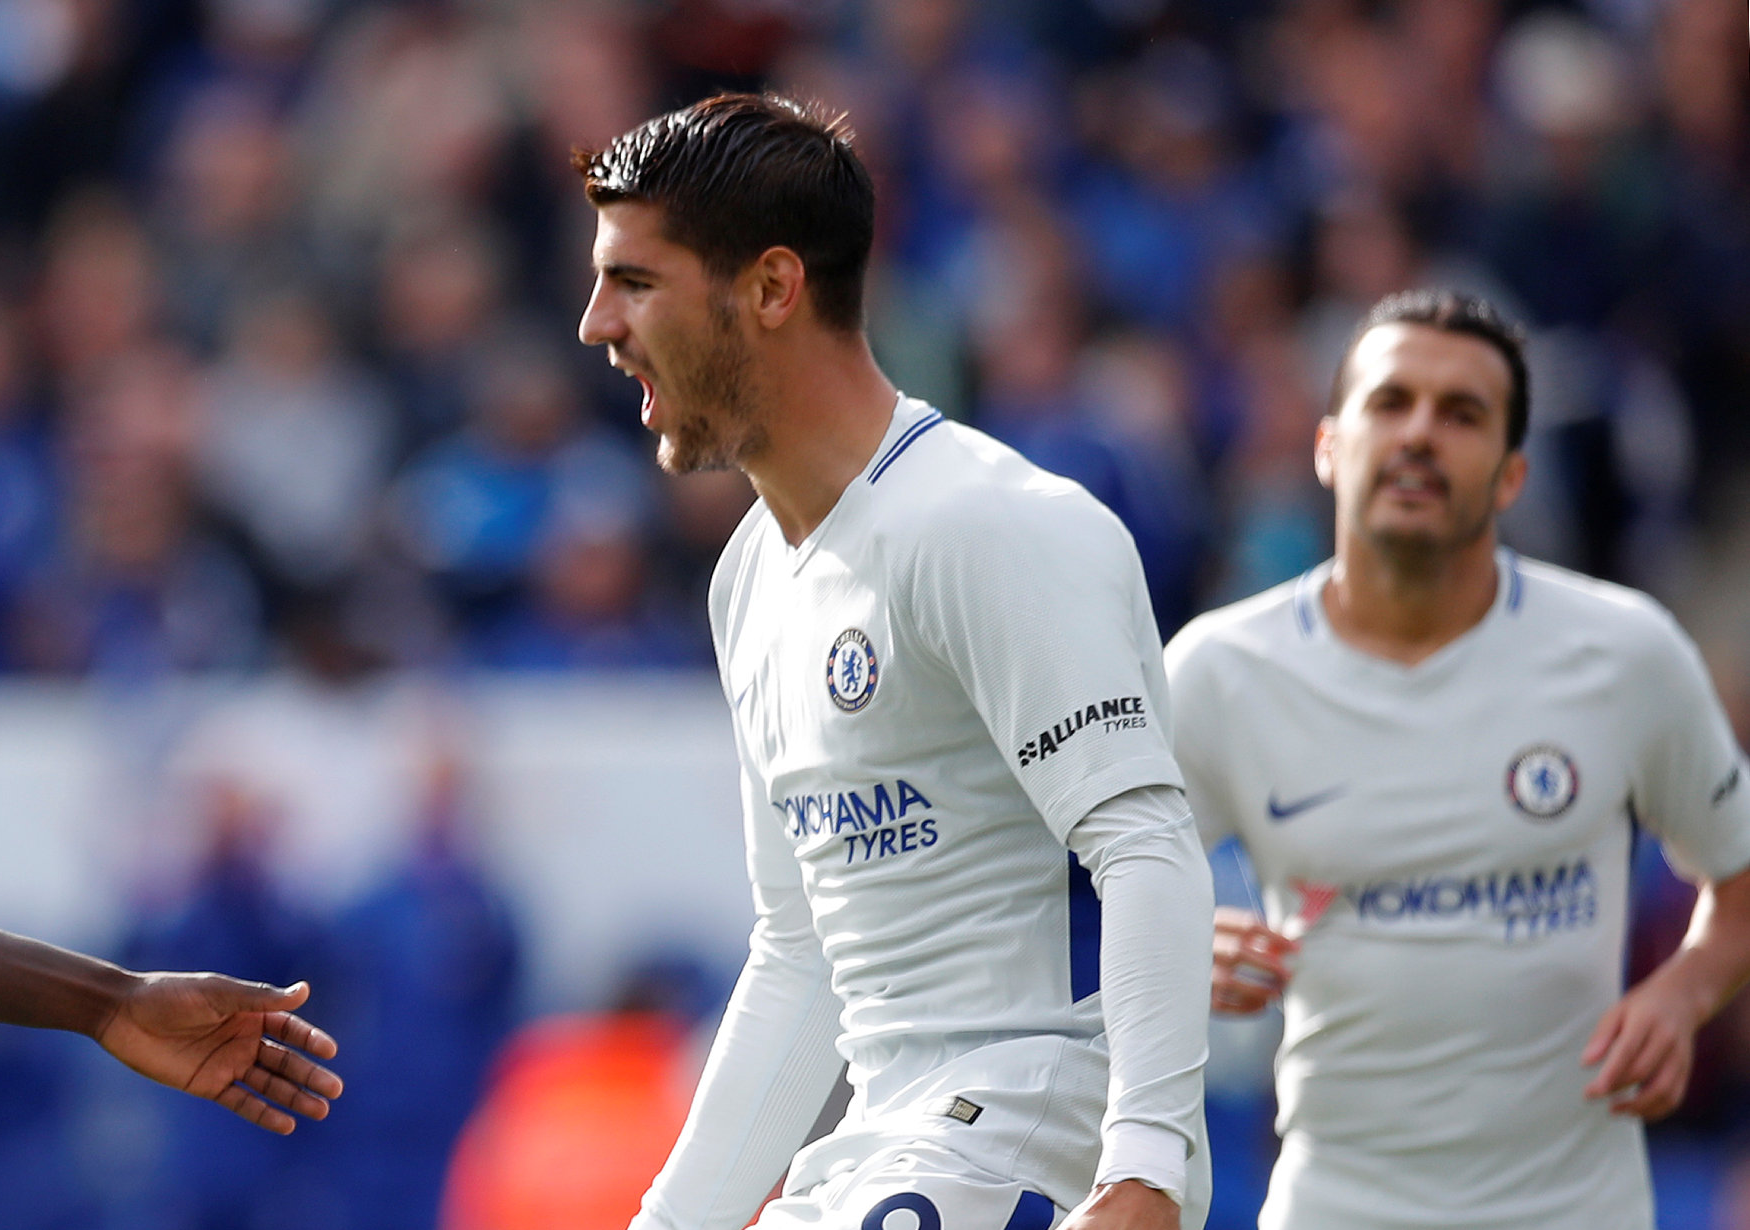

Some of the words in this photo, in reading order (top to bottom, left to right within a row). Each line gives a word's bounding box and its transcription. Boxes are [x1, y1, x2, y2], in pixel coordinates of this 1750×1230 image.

[1038, 697, 1145, 761] ALLIANCE
[1104, 717, 1147, 734] TYRES
[844, 819, 938, 865] TYRES
[1348, 860, 1594, 921] YOKOHAMA
